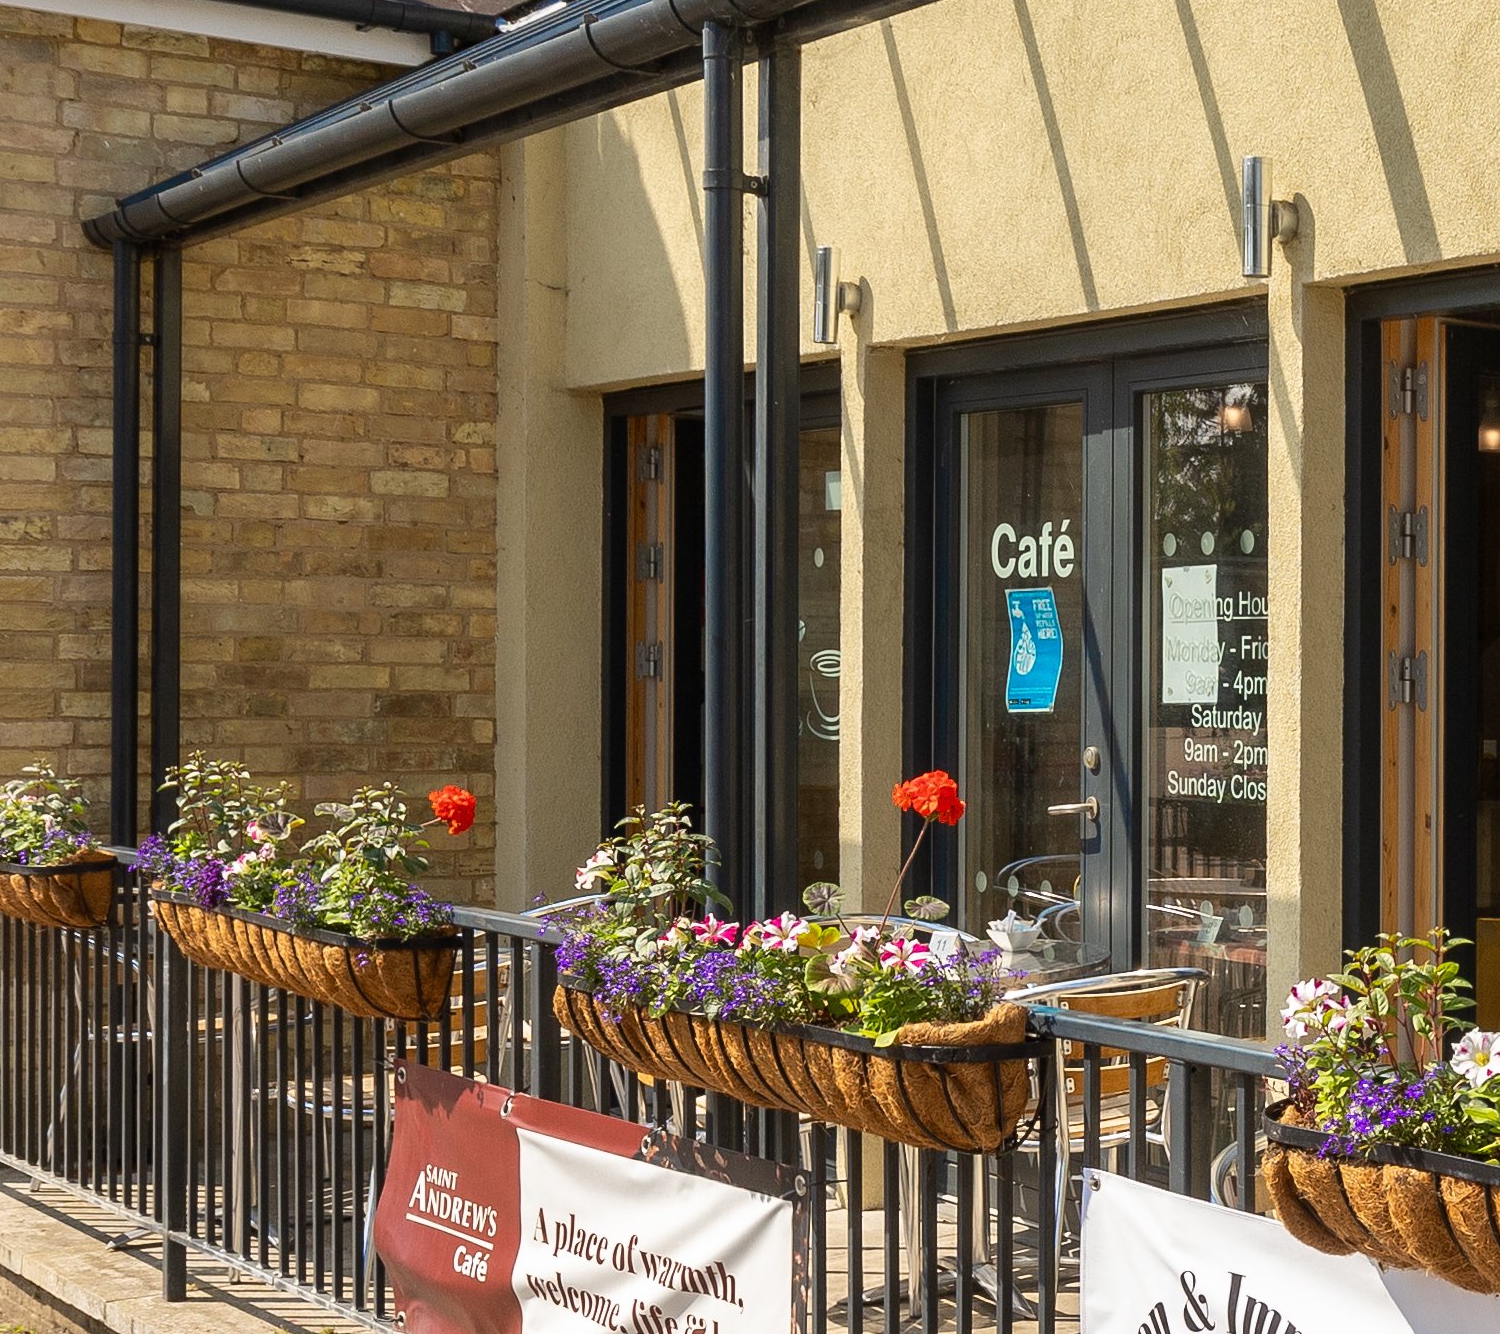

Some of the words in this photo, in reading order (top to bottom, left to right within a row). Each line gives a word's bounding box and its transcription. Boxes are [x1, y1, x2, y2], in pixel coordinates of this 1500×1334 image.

[991, 518, 1075, 579] Café
[1169, 590, 1234, 622] Opening
[1166, 635, 1226, 666] Monday
[1233, 670, 1268, 701] 4pm
[1191, 703, 1263, 736] Saturday
[1184, 737, 1219, 763] 9am
[1233, 739, 1268, 771] 2pm
[1167, 770, 1227, 804] Sunday
[426, 1163, 459, 1191] SAINT
[408, 1170, 498, 1237] ANDREW'S
[453, 1244, 491, 1283] Café
[533, 1207, 549, 1245] A
[553, 1212, 609, 1265] place
[612, 1234, 639, 1275] of
[639, 1250, 744, 1315] warmth,
[1179, 1270, 1216, 1333] &
